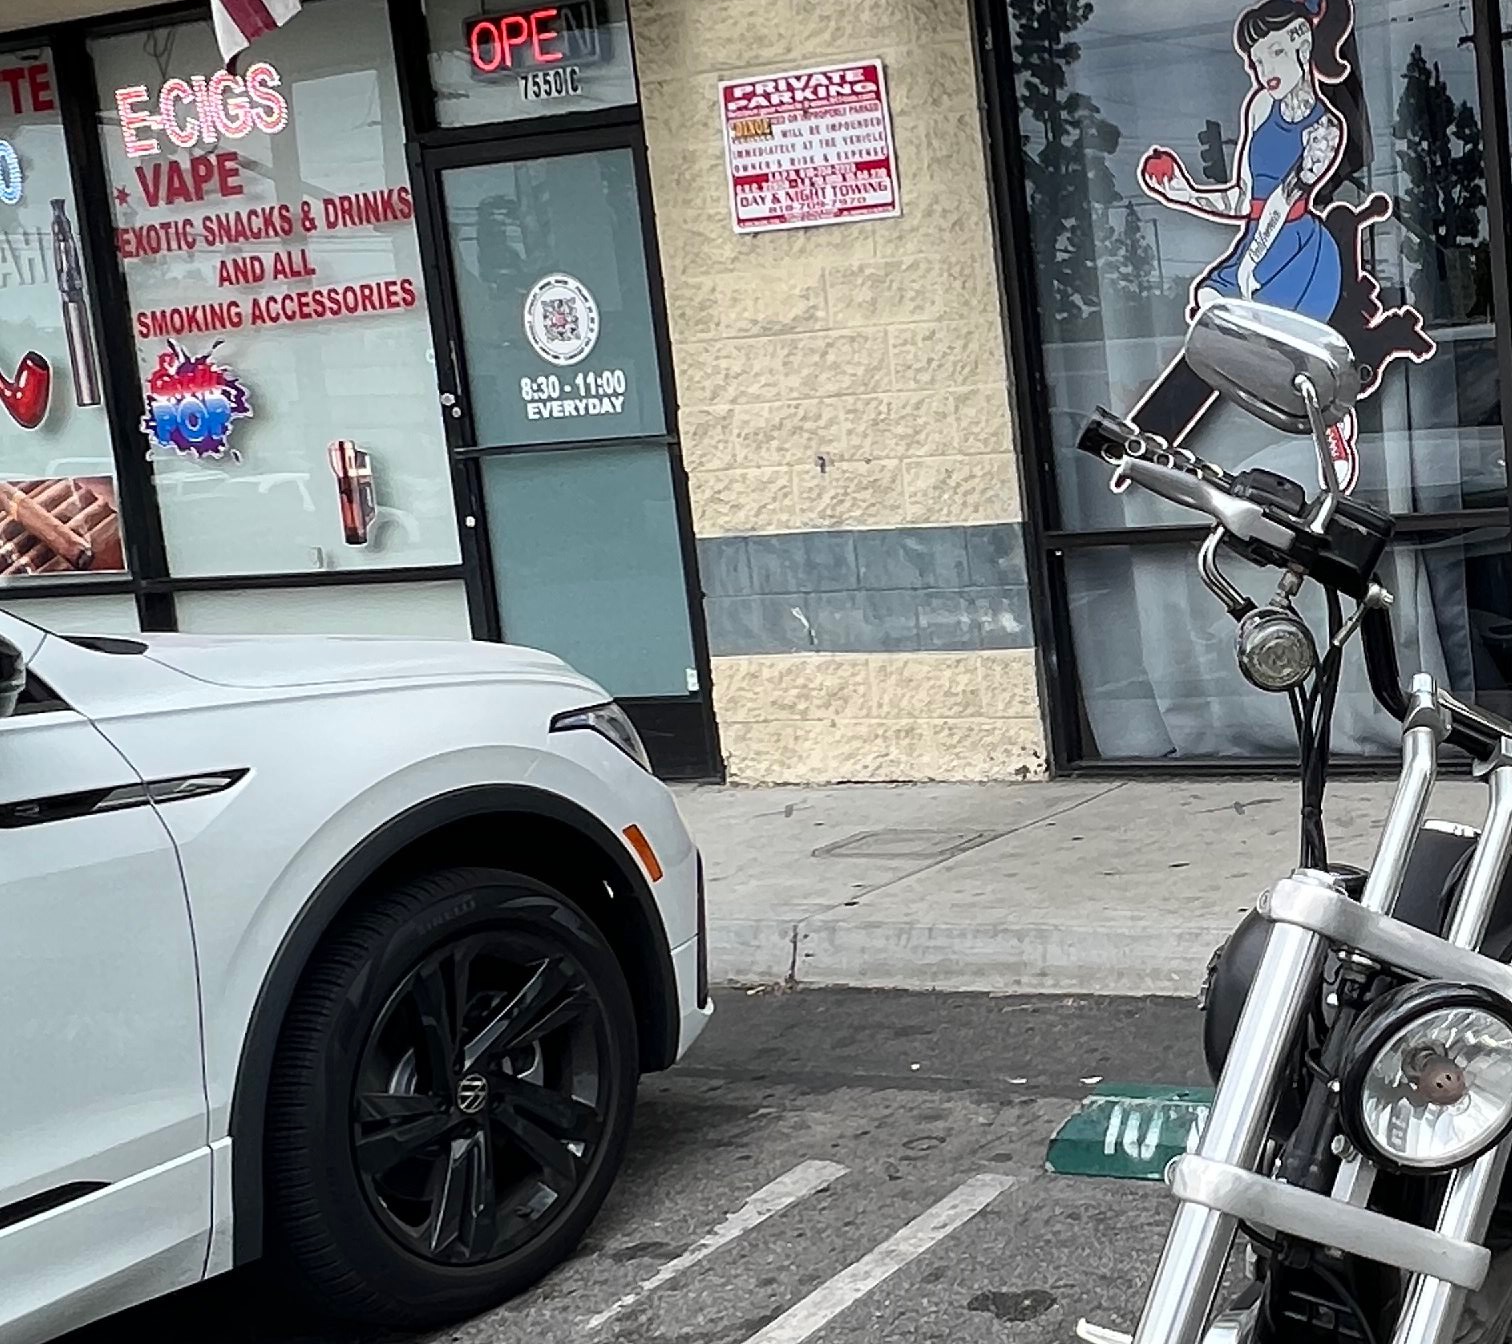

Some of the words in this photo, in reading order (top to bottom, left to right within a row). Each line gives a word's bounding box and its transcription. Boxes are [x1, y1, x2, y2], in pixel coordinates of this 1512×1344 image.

[727, 82, 877, 110] PARKING
[732, 69, 864, 97] PRIVATE
[135, 151, 244, 207] VAPE
[740, 194, 767, 208] DAY
[770, 191, 782, 205] &
[785, 186, 827, 203] NIGHT
[831, 181, 888, 197] TOWING
[119, 218, 197, 258] EXOTIC
[203, 203, 293, 246] SNACKS
[300, 201, 317, 232] &
[323, 186, 414, 229] DRINKS
[218, 255, 265, 287] AND
[273, 248, 316, 280] ALL
[137, 300, 243, 339] SMOKING
[250, 278, 416, 325] ACCESSORIES
[520, 374, 560, 401] 8:30
[575, 369, 627, 396] 11:00
[527, 396, 624, 420] EVERYDAY
